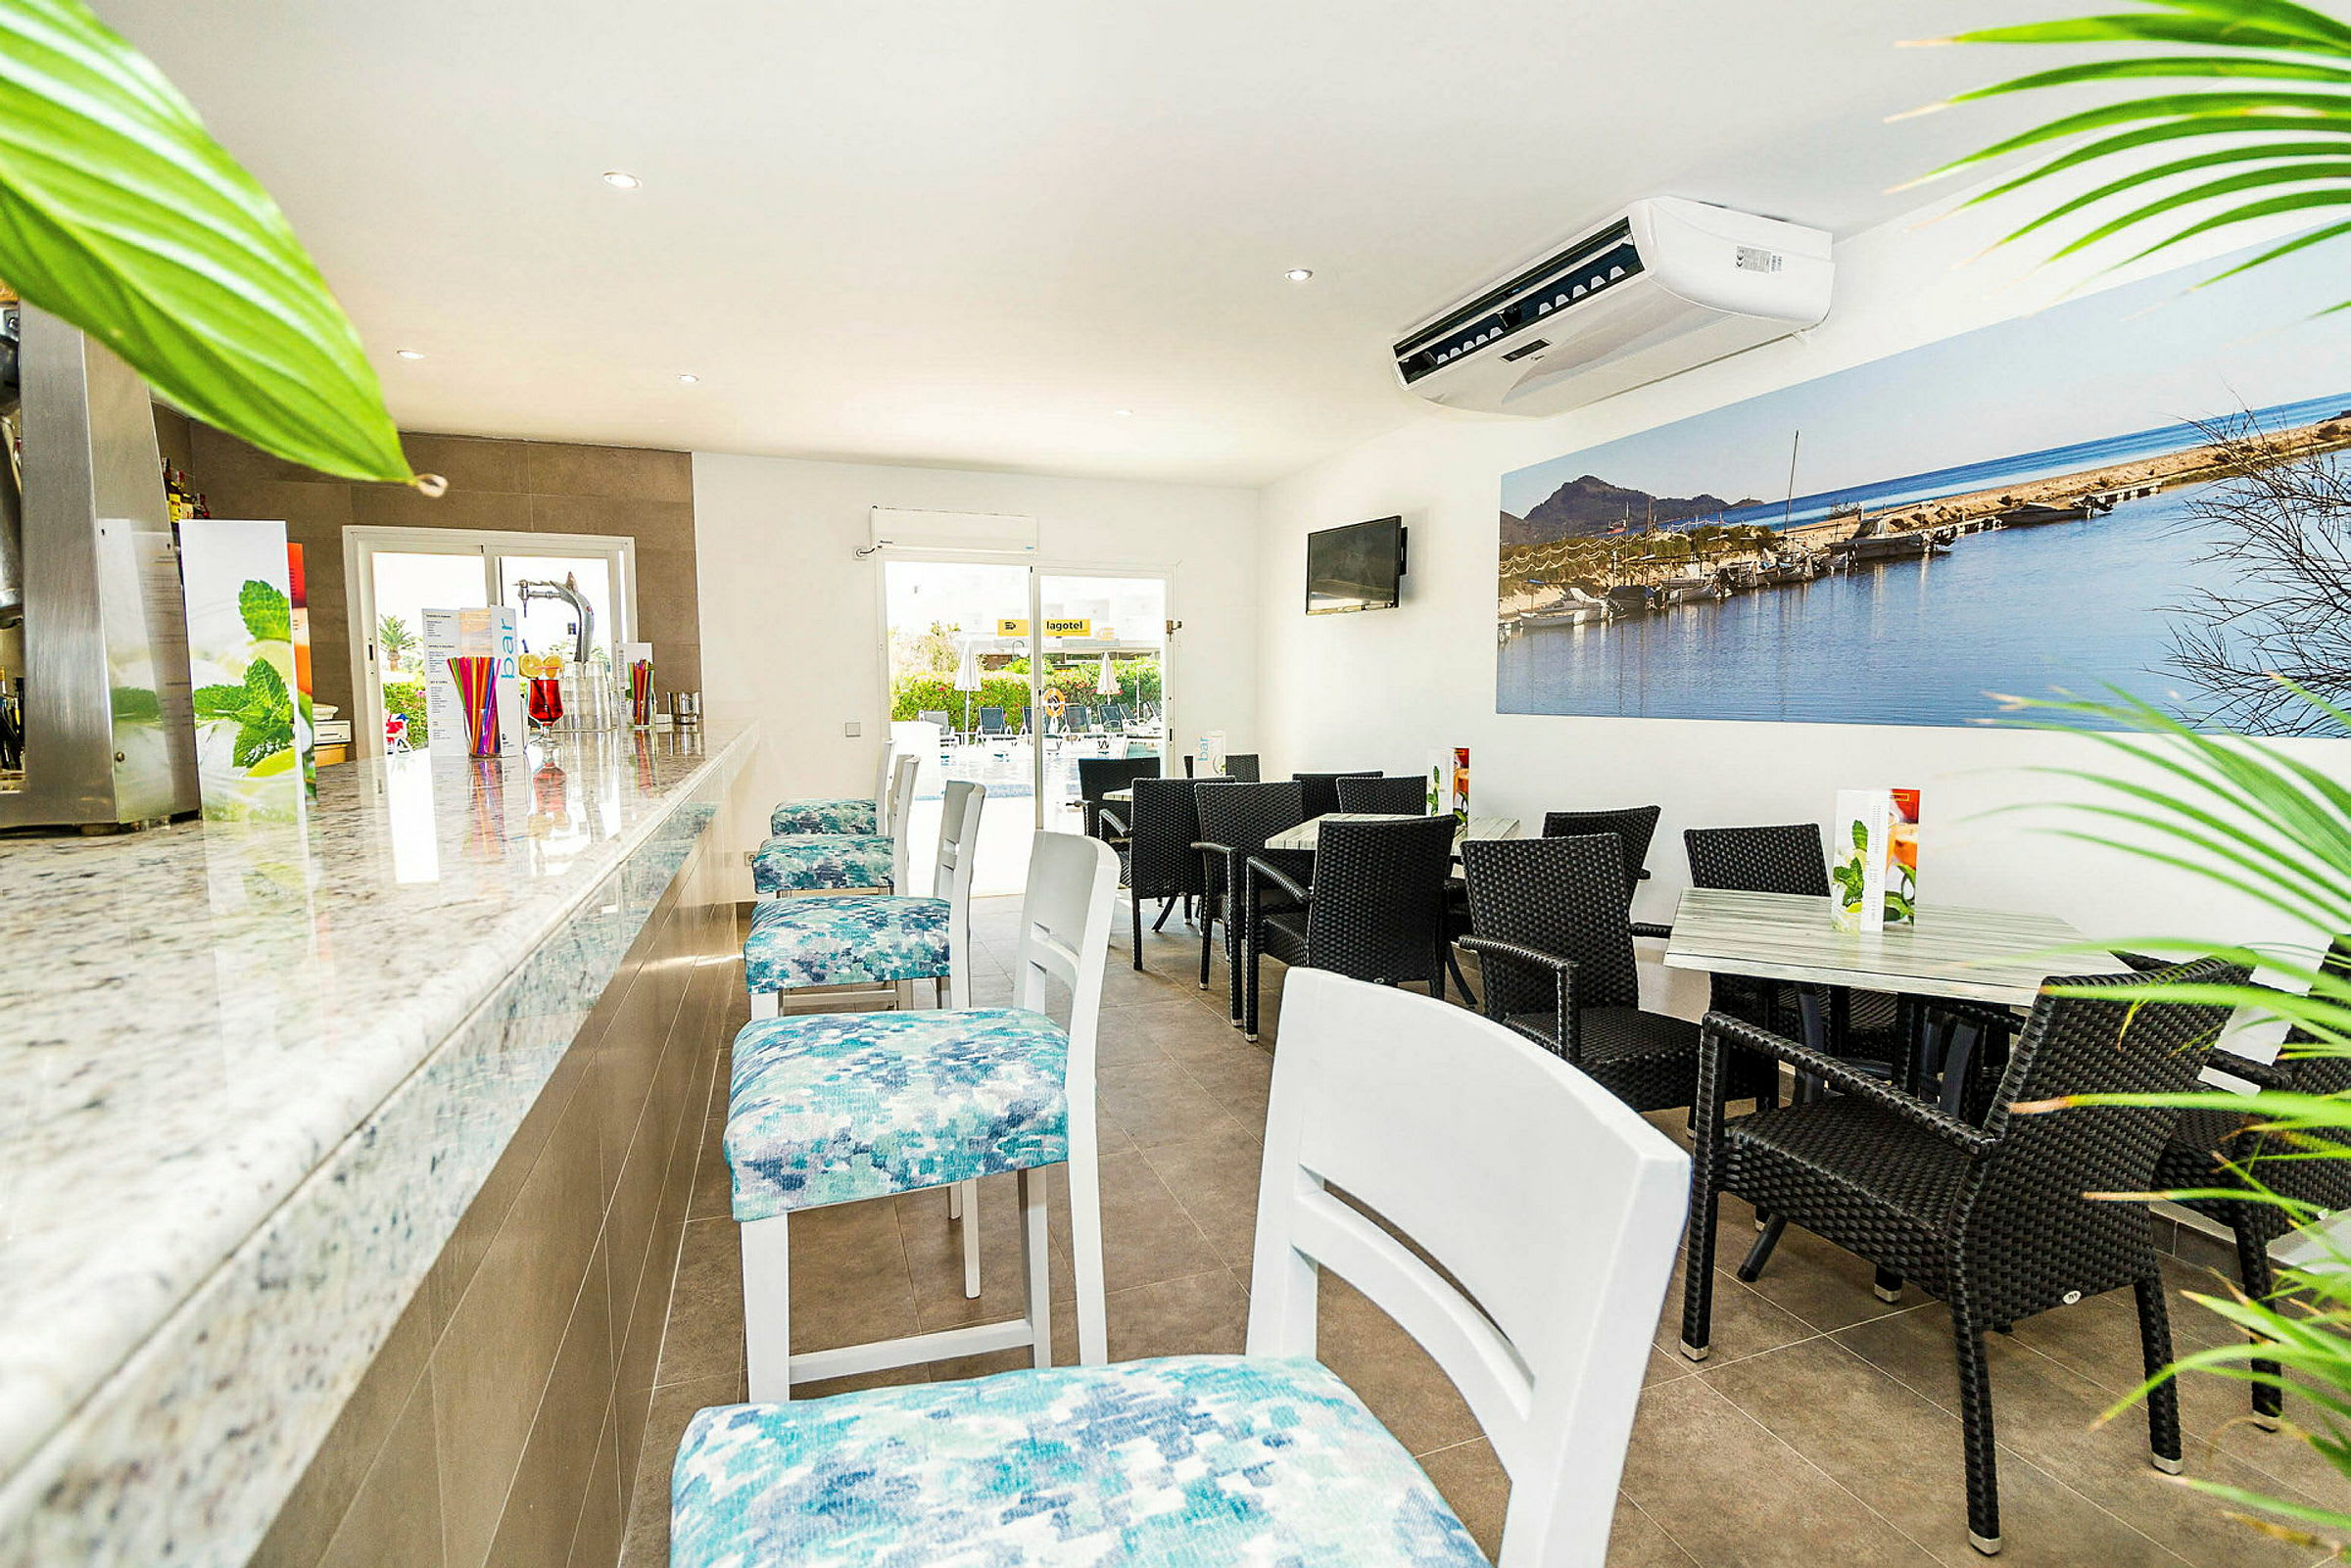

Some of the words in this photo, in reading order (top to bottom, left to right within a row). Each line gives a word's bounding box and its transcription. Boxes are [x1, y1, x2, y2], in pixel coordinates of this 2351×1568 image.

[1046, 620, 1082, 631] lagotel
[501, 618, 514, 678] bar
[1197, 736, 1210, 761] bar
